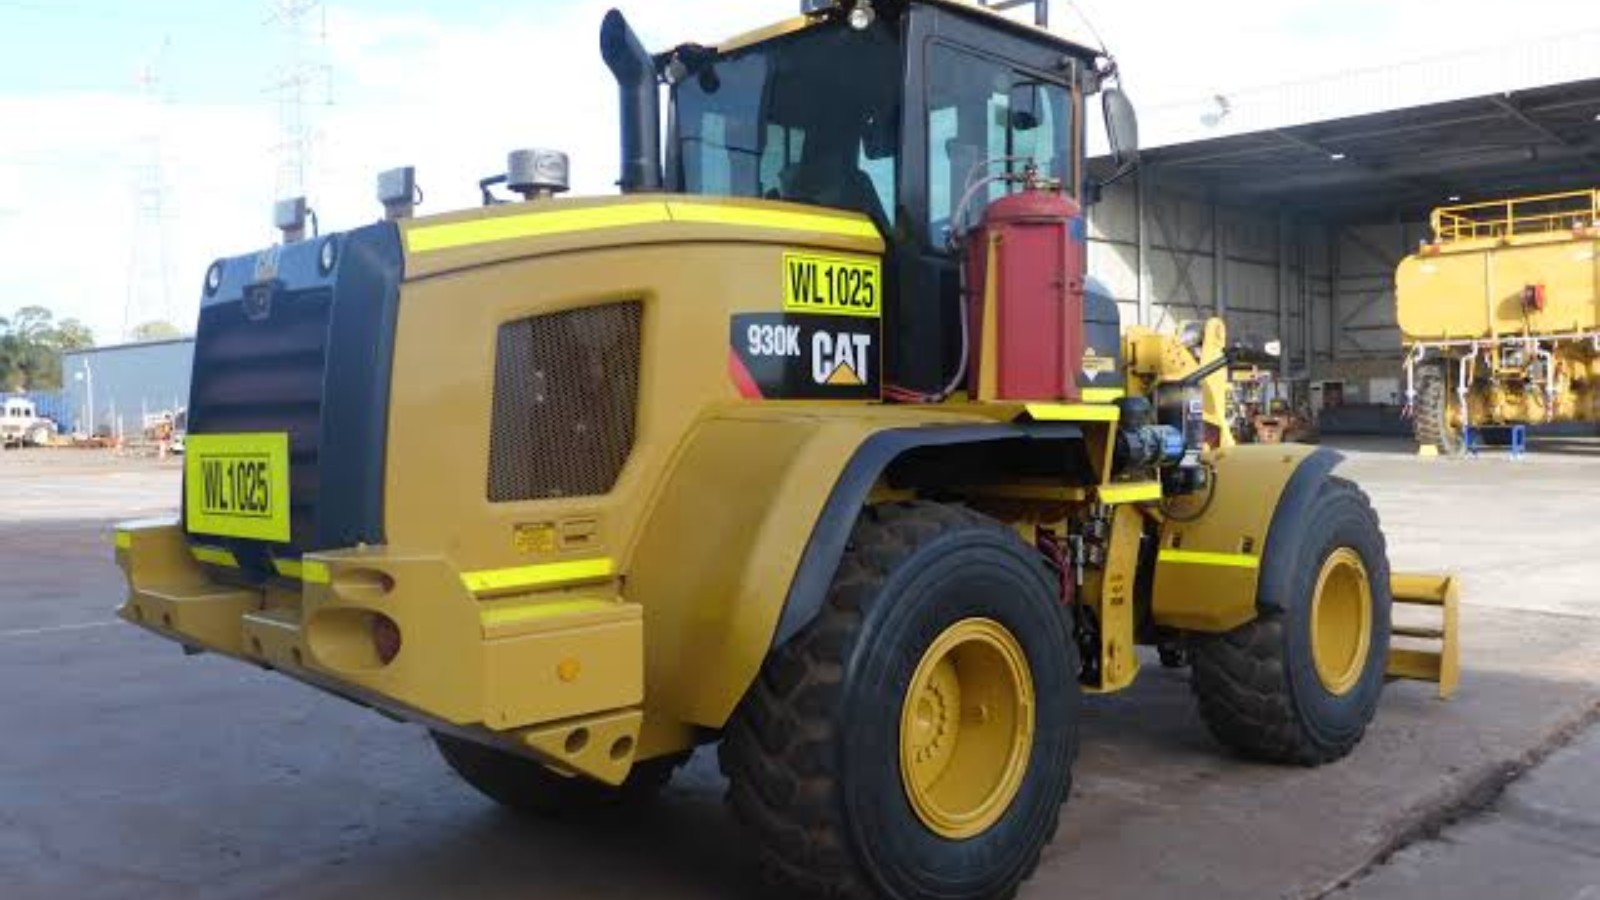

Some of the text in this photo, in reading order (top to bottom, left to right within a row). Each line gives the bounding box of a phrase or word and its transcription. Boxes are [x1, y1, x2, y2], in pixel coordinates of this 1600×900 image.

[789, 261, 874, 308] WL1025
[747, 323, 801, 357] 930K
[812, 330, 871, 385] CAT
[202, 460, 268, 513] WL1025
